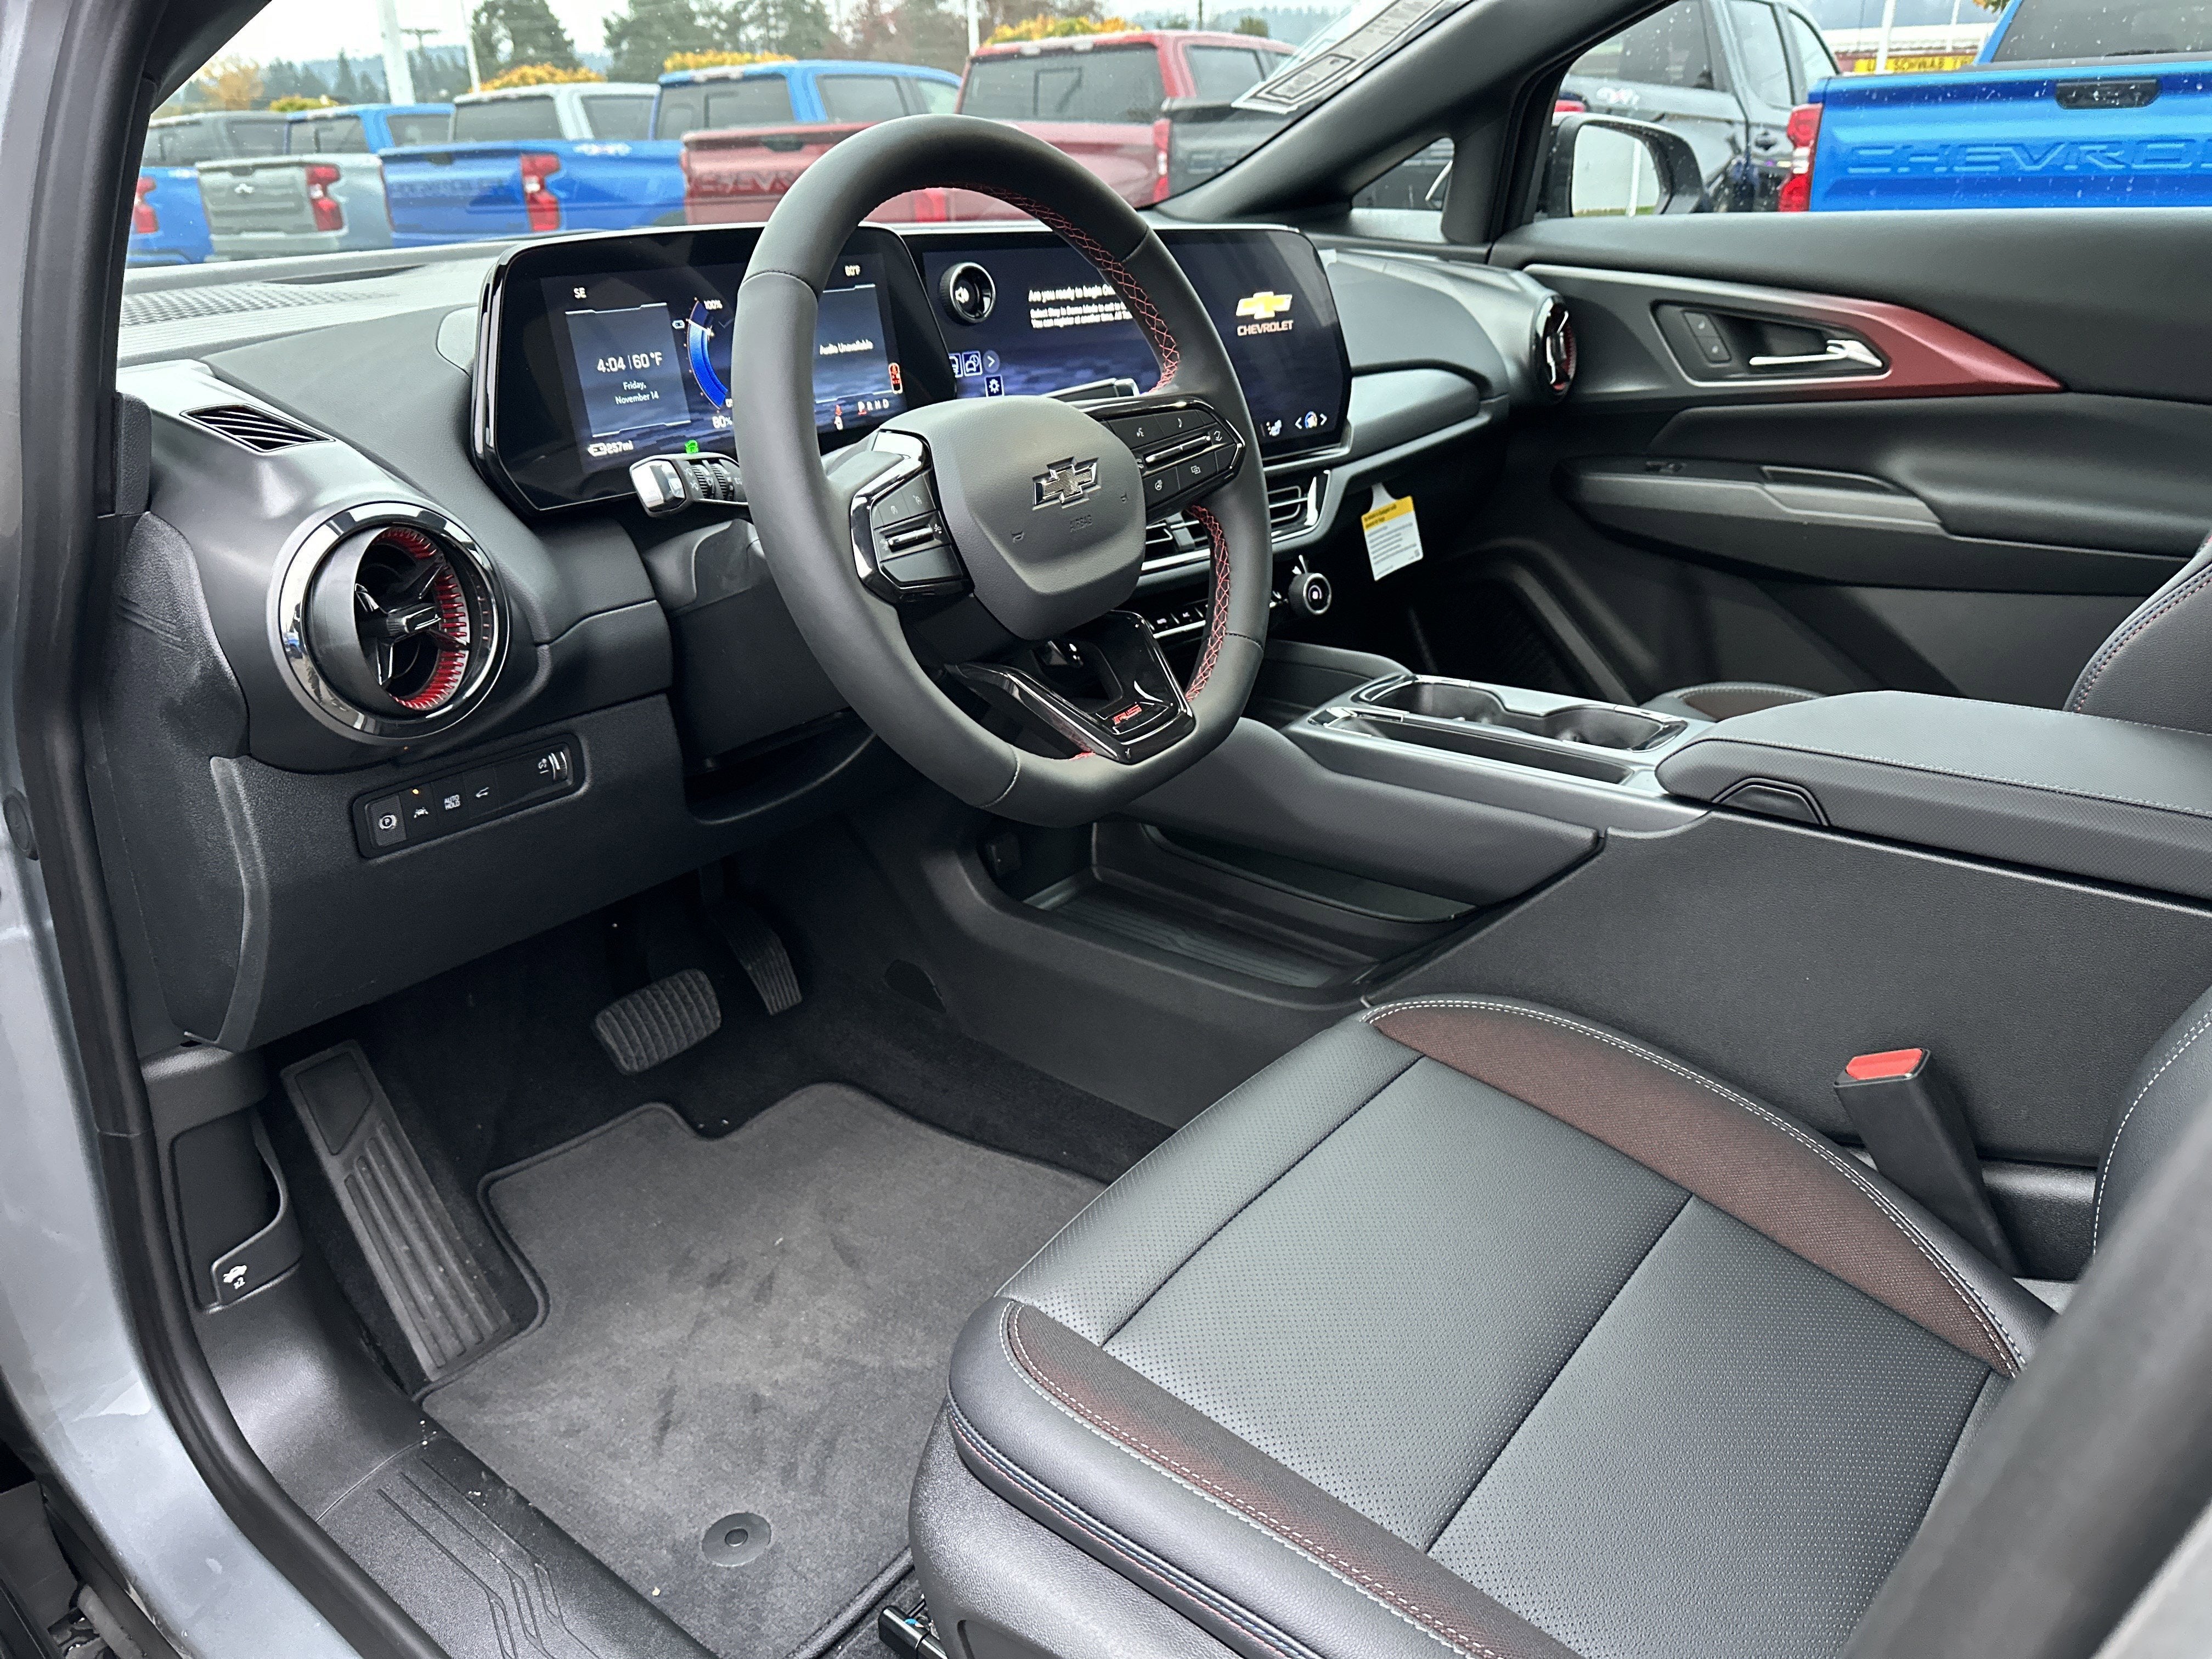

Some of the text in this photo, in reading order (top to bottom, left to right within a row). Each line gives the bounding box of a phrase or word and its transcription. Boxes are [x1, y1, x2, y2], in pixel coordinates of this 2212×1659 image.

[574, 287, 587, 299] SE
[1237, 319, 1294, 336] CHEVROLET
[597, 357, 625, 373] 4:04
[623, 381, 647, 391] Friday,
[615, 391, 659, 404] November 14
[1111, 704, 1142, 725] RS
